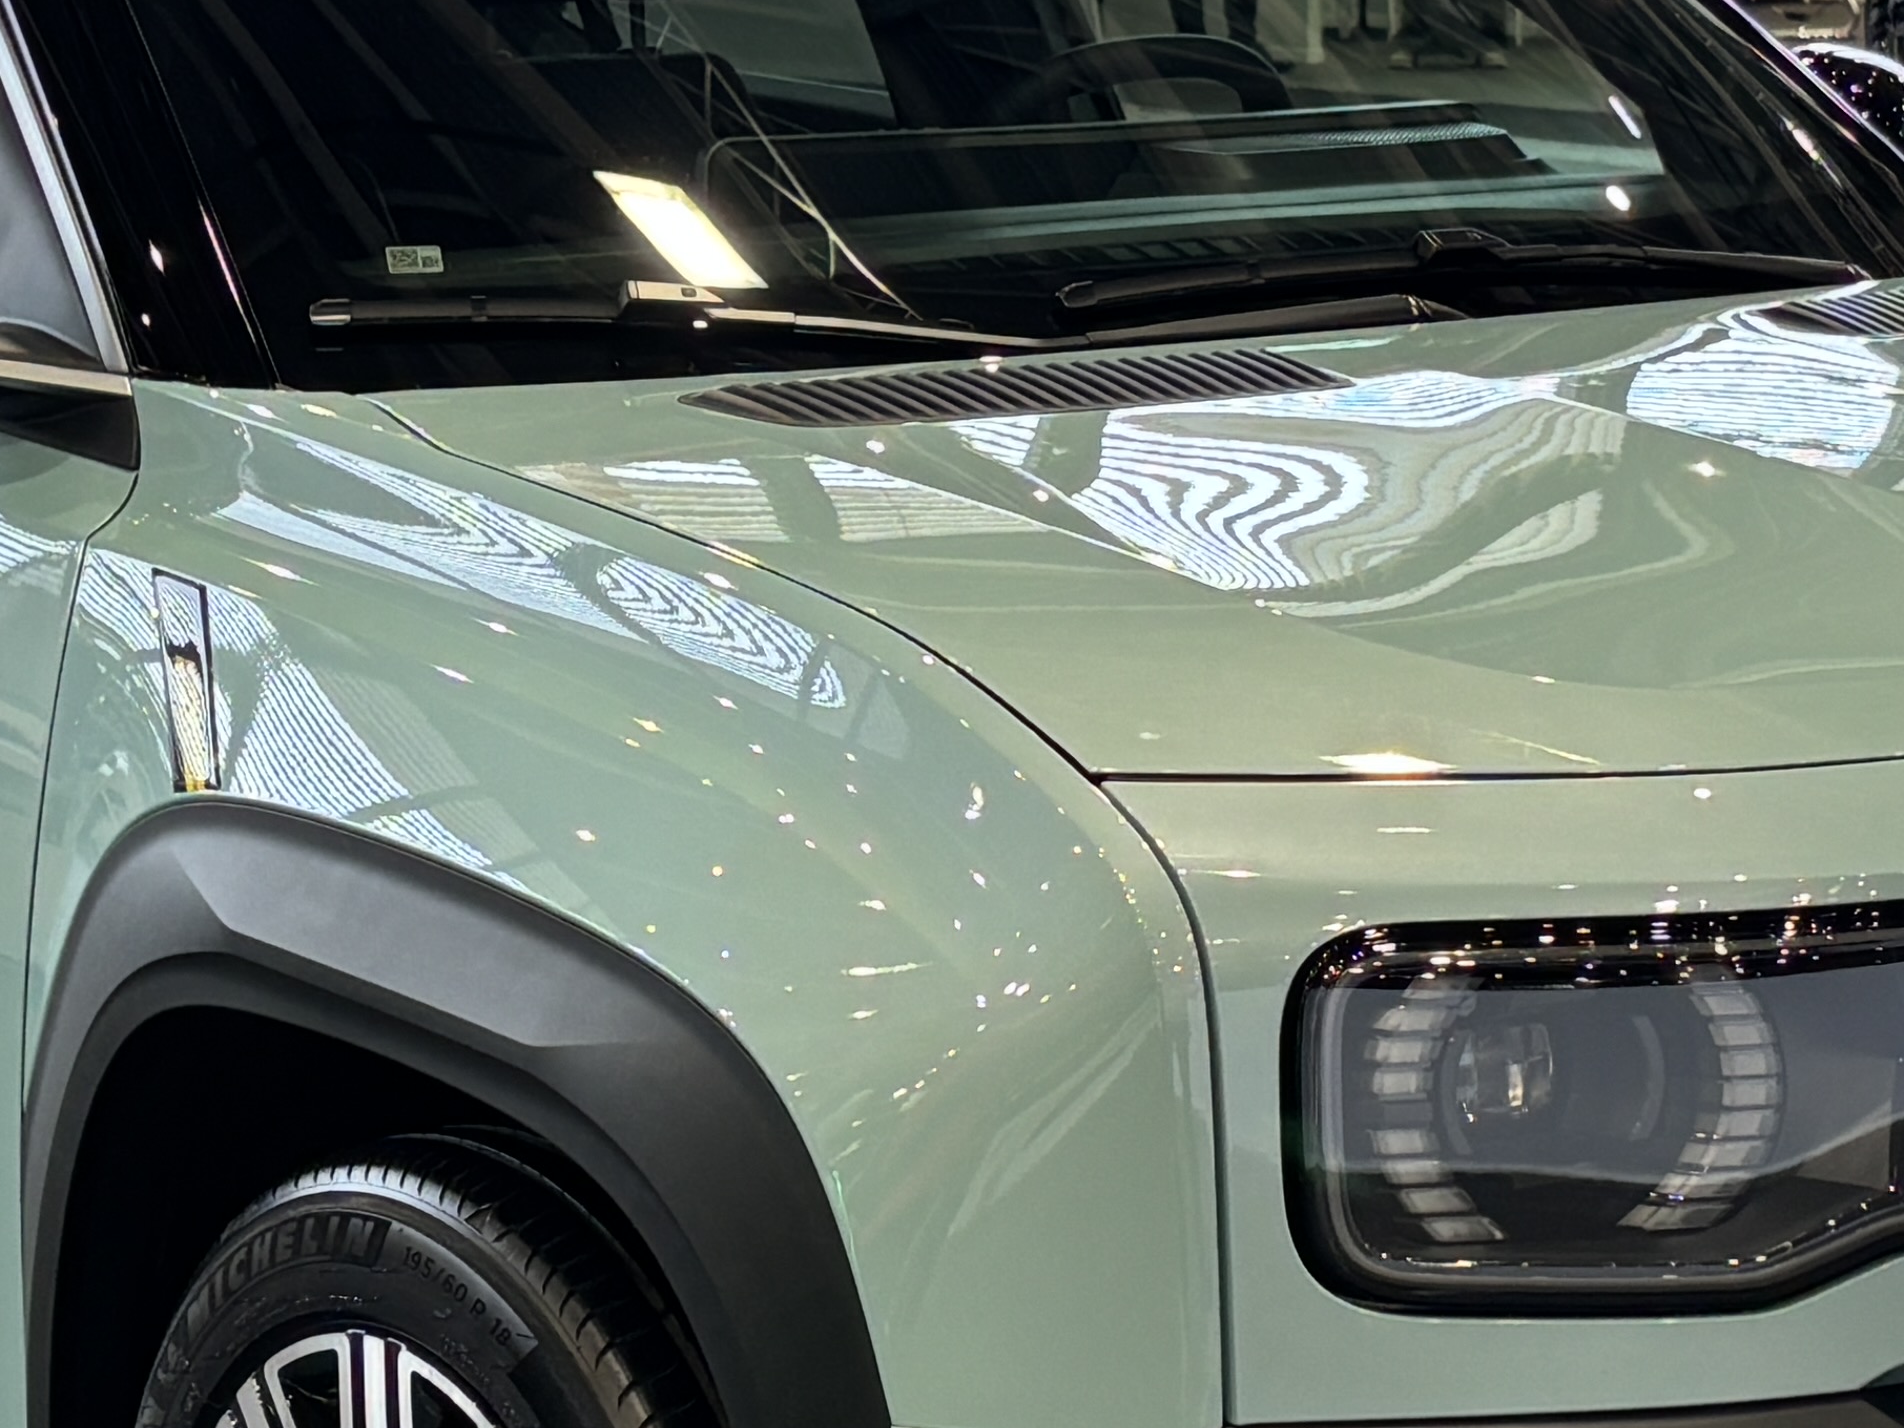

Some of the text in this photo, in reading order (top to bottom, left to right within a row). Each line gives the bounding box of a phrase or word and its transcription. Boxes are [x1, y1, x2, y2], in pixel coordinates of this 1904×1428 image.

[183, 1213, 377, 1340] MICHELIN
[402, 1245, 469, 1303] 195/60
[491, 1315, 513, 1345] 18
